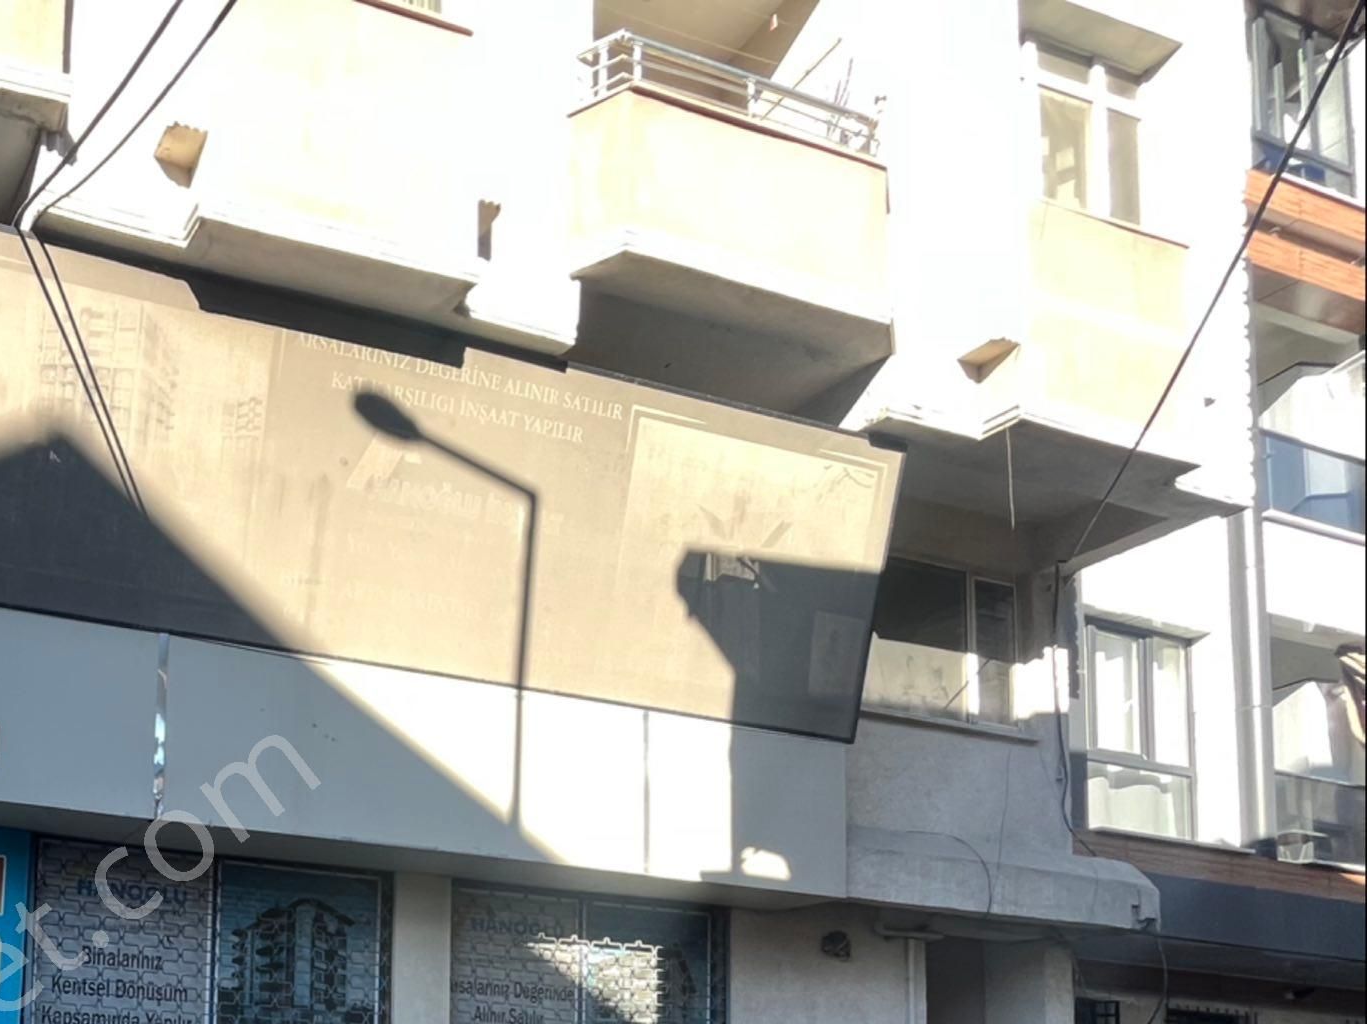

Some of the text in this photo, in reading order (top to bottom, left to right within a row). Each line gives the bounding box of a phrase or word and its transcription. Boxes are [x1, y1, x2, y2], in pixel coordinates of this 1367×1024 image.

[460, 393, 520, 427] İNŞAAT
[523, 414, 584, 444] YAPILIR
[504, 380, 559, 405] ALINIR
[563, 391, 624, 422] SATILIR
[82, 945, 164, 971] Binalarınız
[52, 975, 188, 1006] Kentsel Dönüşüm
